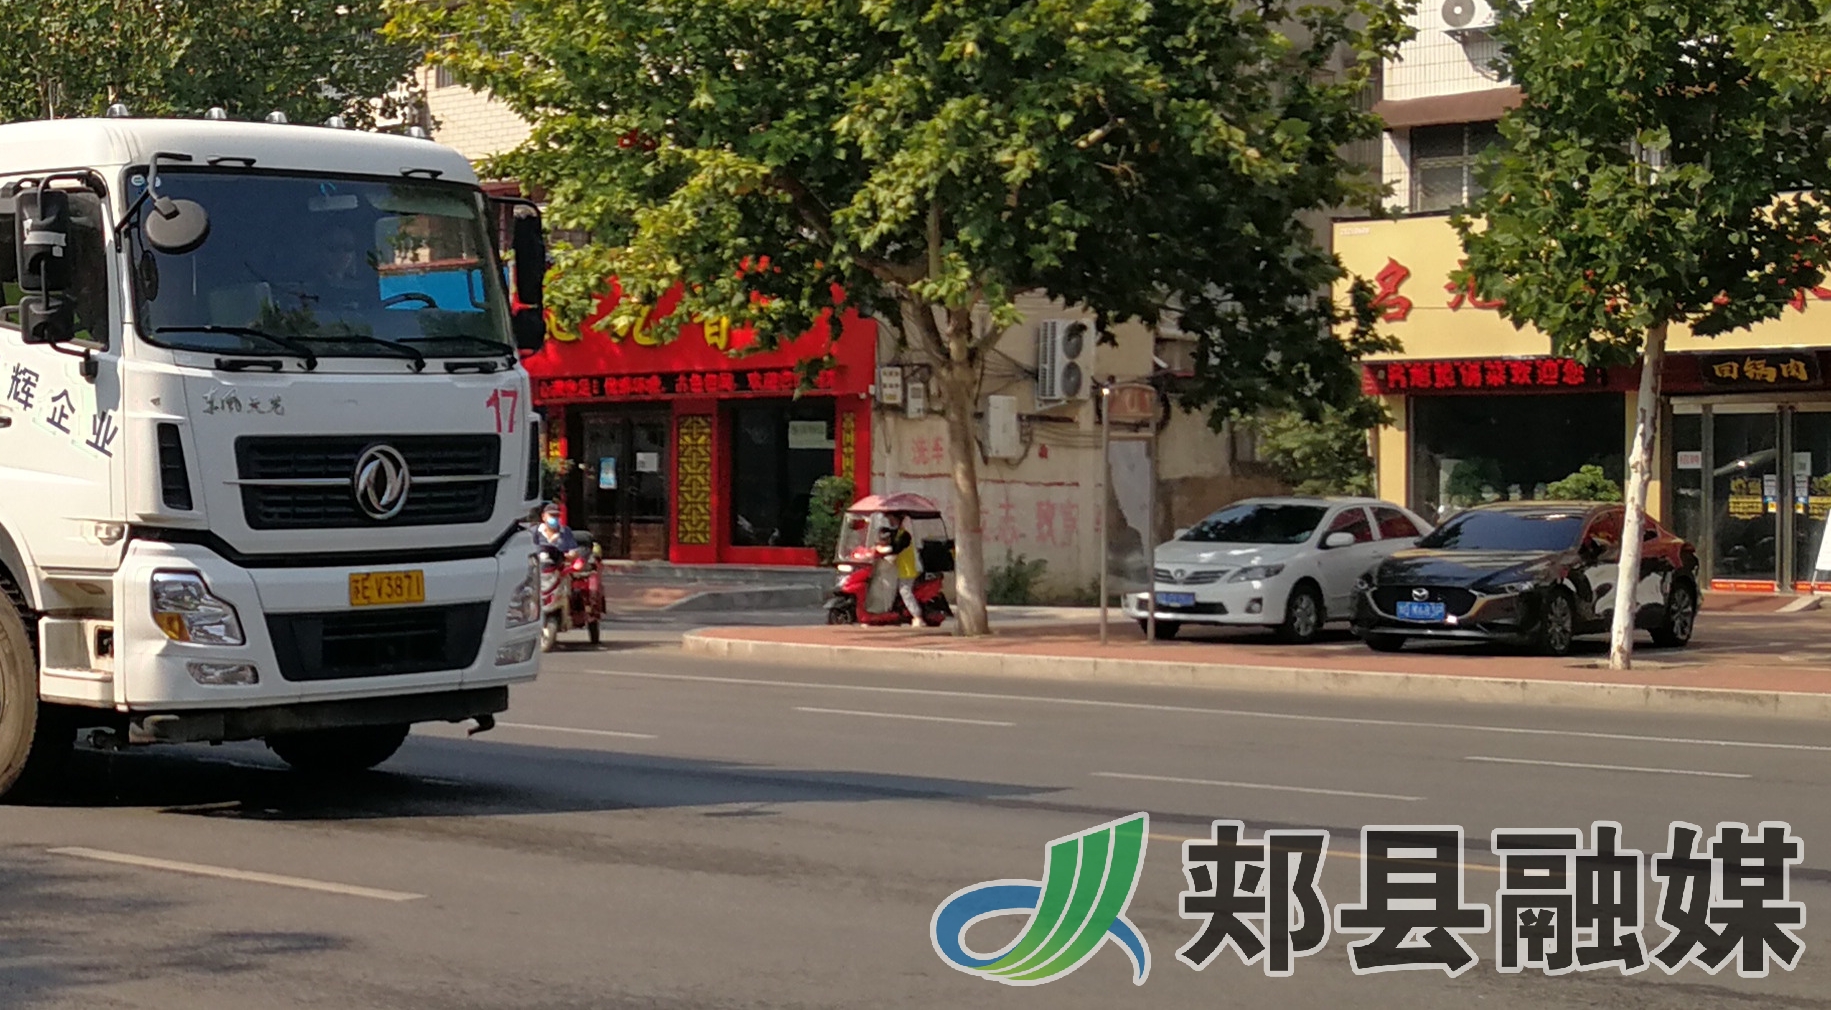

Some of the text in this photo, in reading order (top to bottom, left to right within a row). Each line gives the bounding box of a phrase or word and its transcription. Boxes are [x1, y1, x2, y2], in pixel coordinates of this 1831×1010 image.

[1713, 356, 1809, 383] 回锅肉
[485, 388, 519, 434] 17
